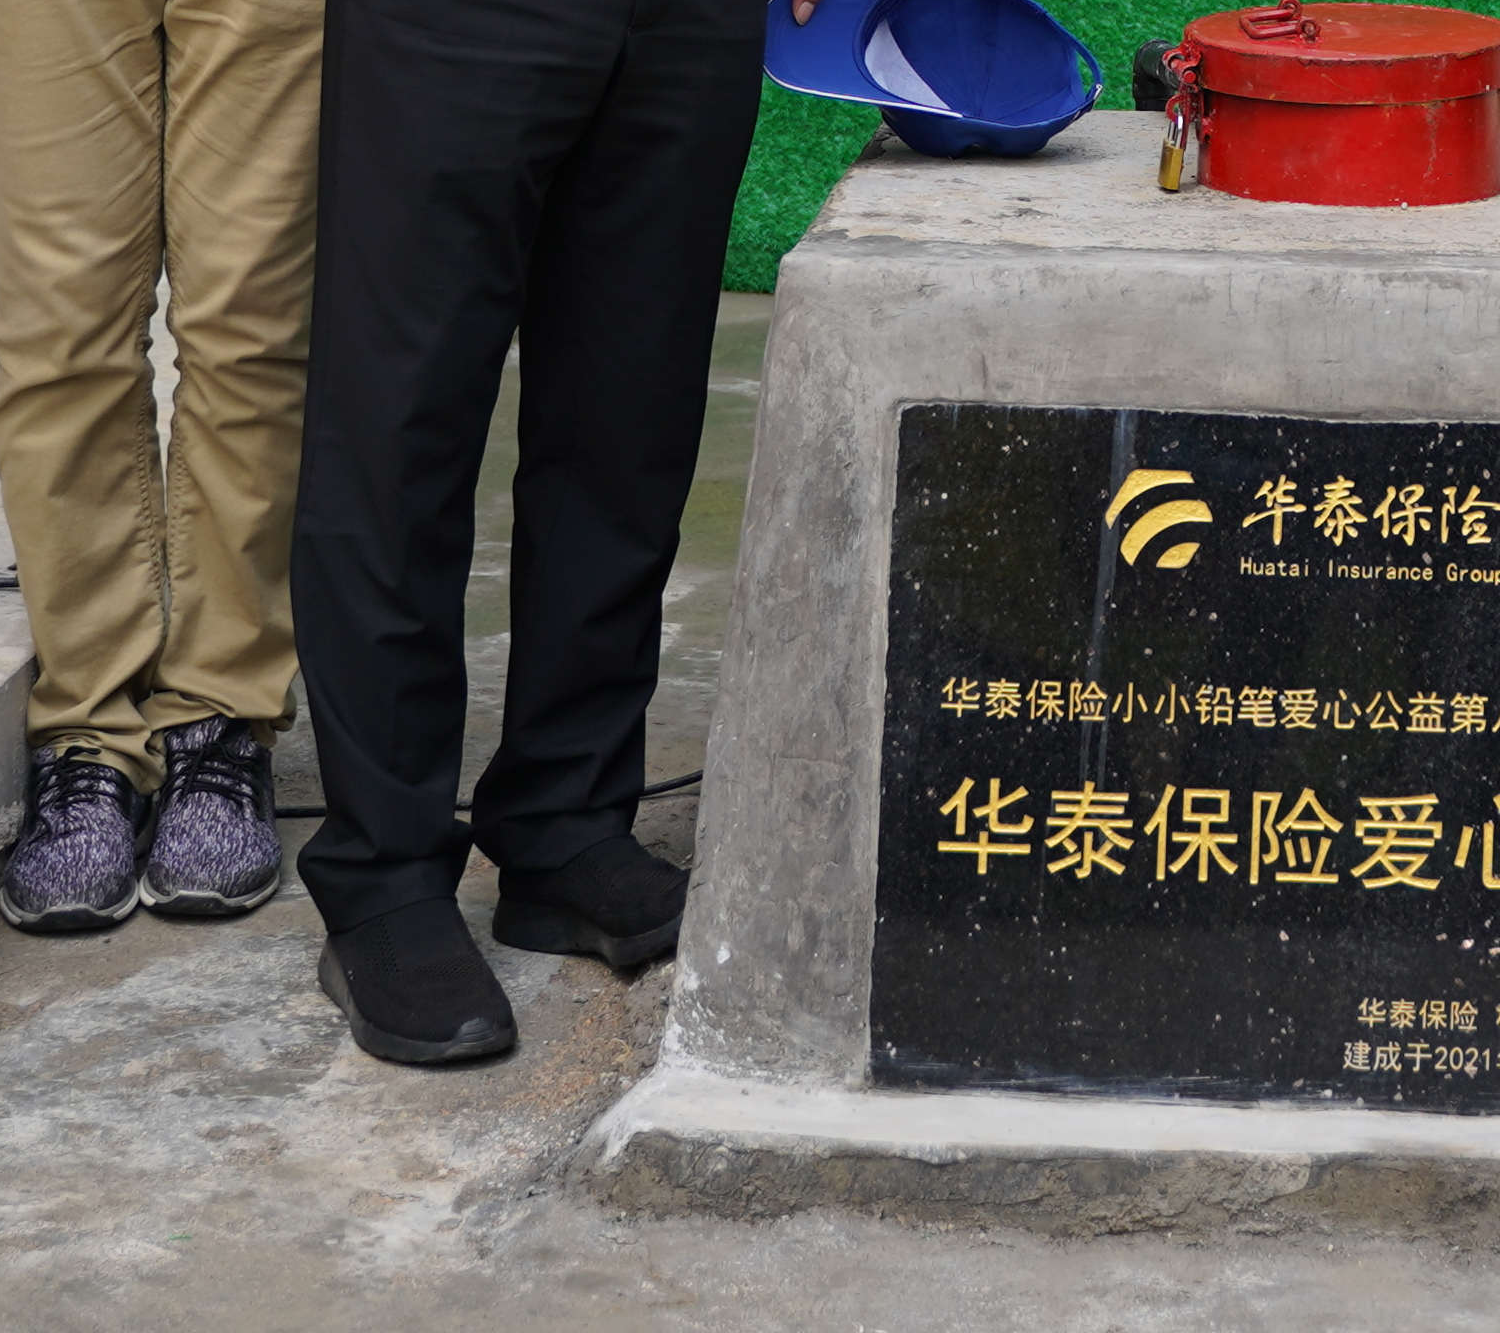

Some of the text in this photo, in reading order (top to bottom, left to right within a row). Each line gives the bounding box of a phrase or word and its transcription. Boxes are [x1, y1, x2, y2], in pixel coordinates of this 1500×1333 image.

[1239, 556, 1310, 578] Huatai
[1328, 559, 1434, 581] Insurance
[1357, 997, 1479, 1032] 华泰保险
